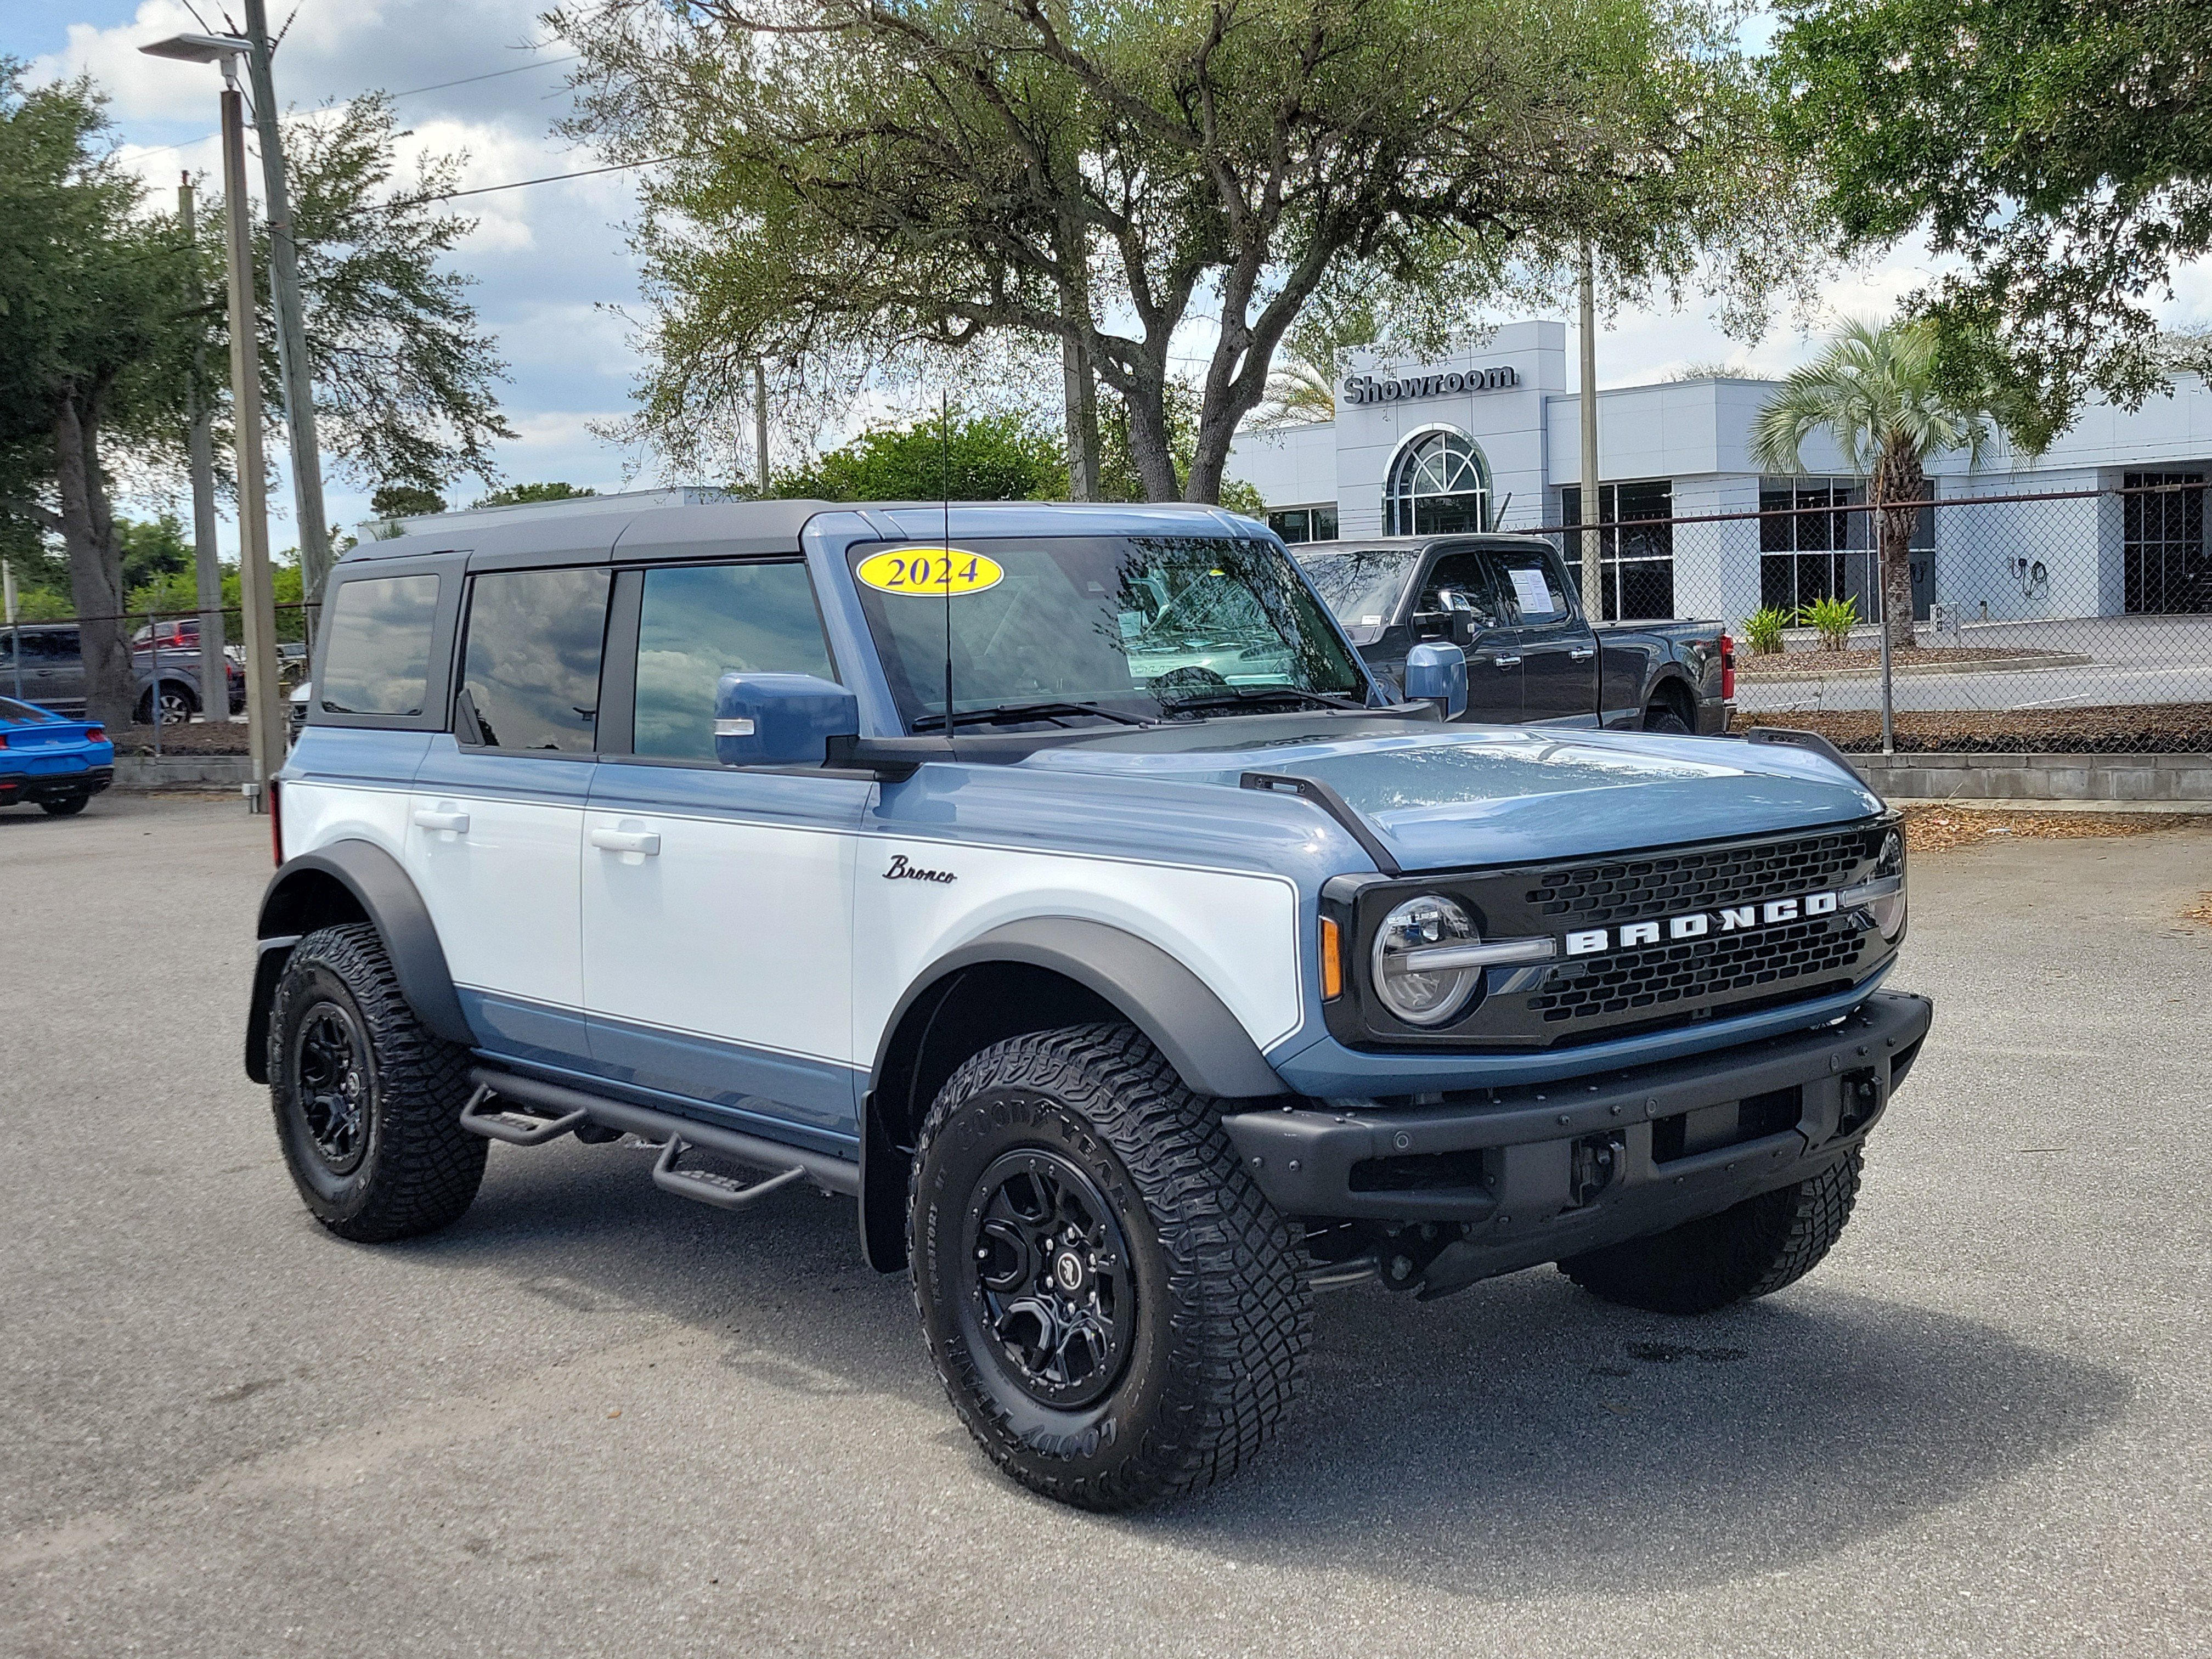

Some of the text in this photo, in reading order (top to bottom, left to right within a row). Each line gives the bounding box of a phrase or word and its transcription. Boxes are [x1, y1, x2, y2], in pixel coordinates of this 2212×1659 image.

[1344, 366, 1516, 404] Showroom
[886, 557, 979, 586] 2024
[882, 854, 958, 884] Bronco
[1565, 892, 1837, 955] BRONCO
